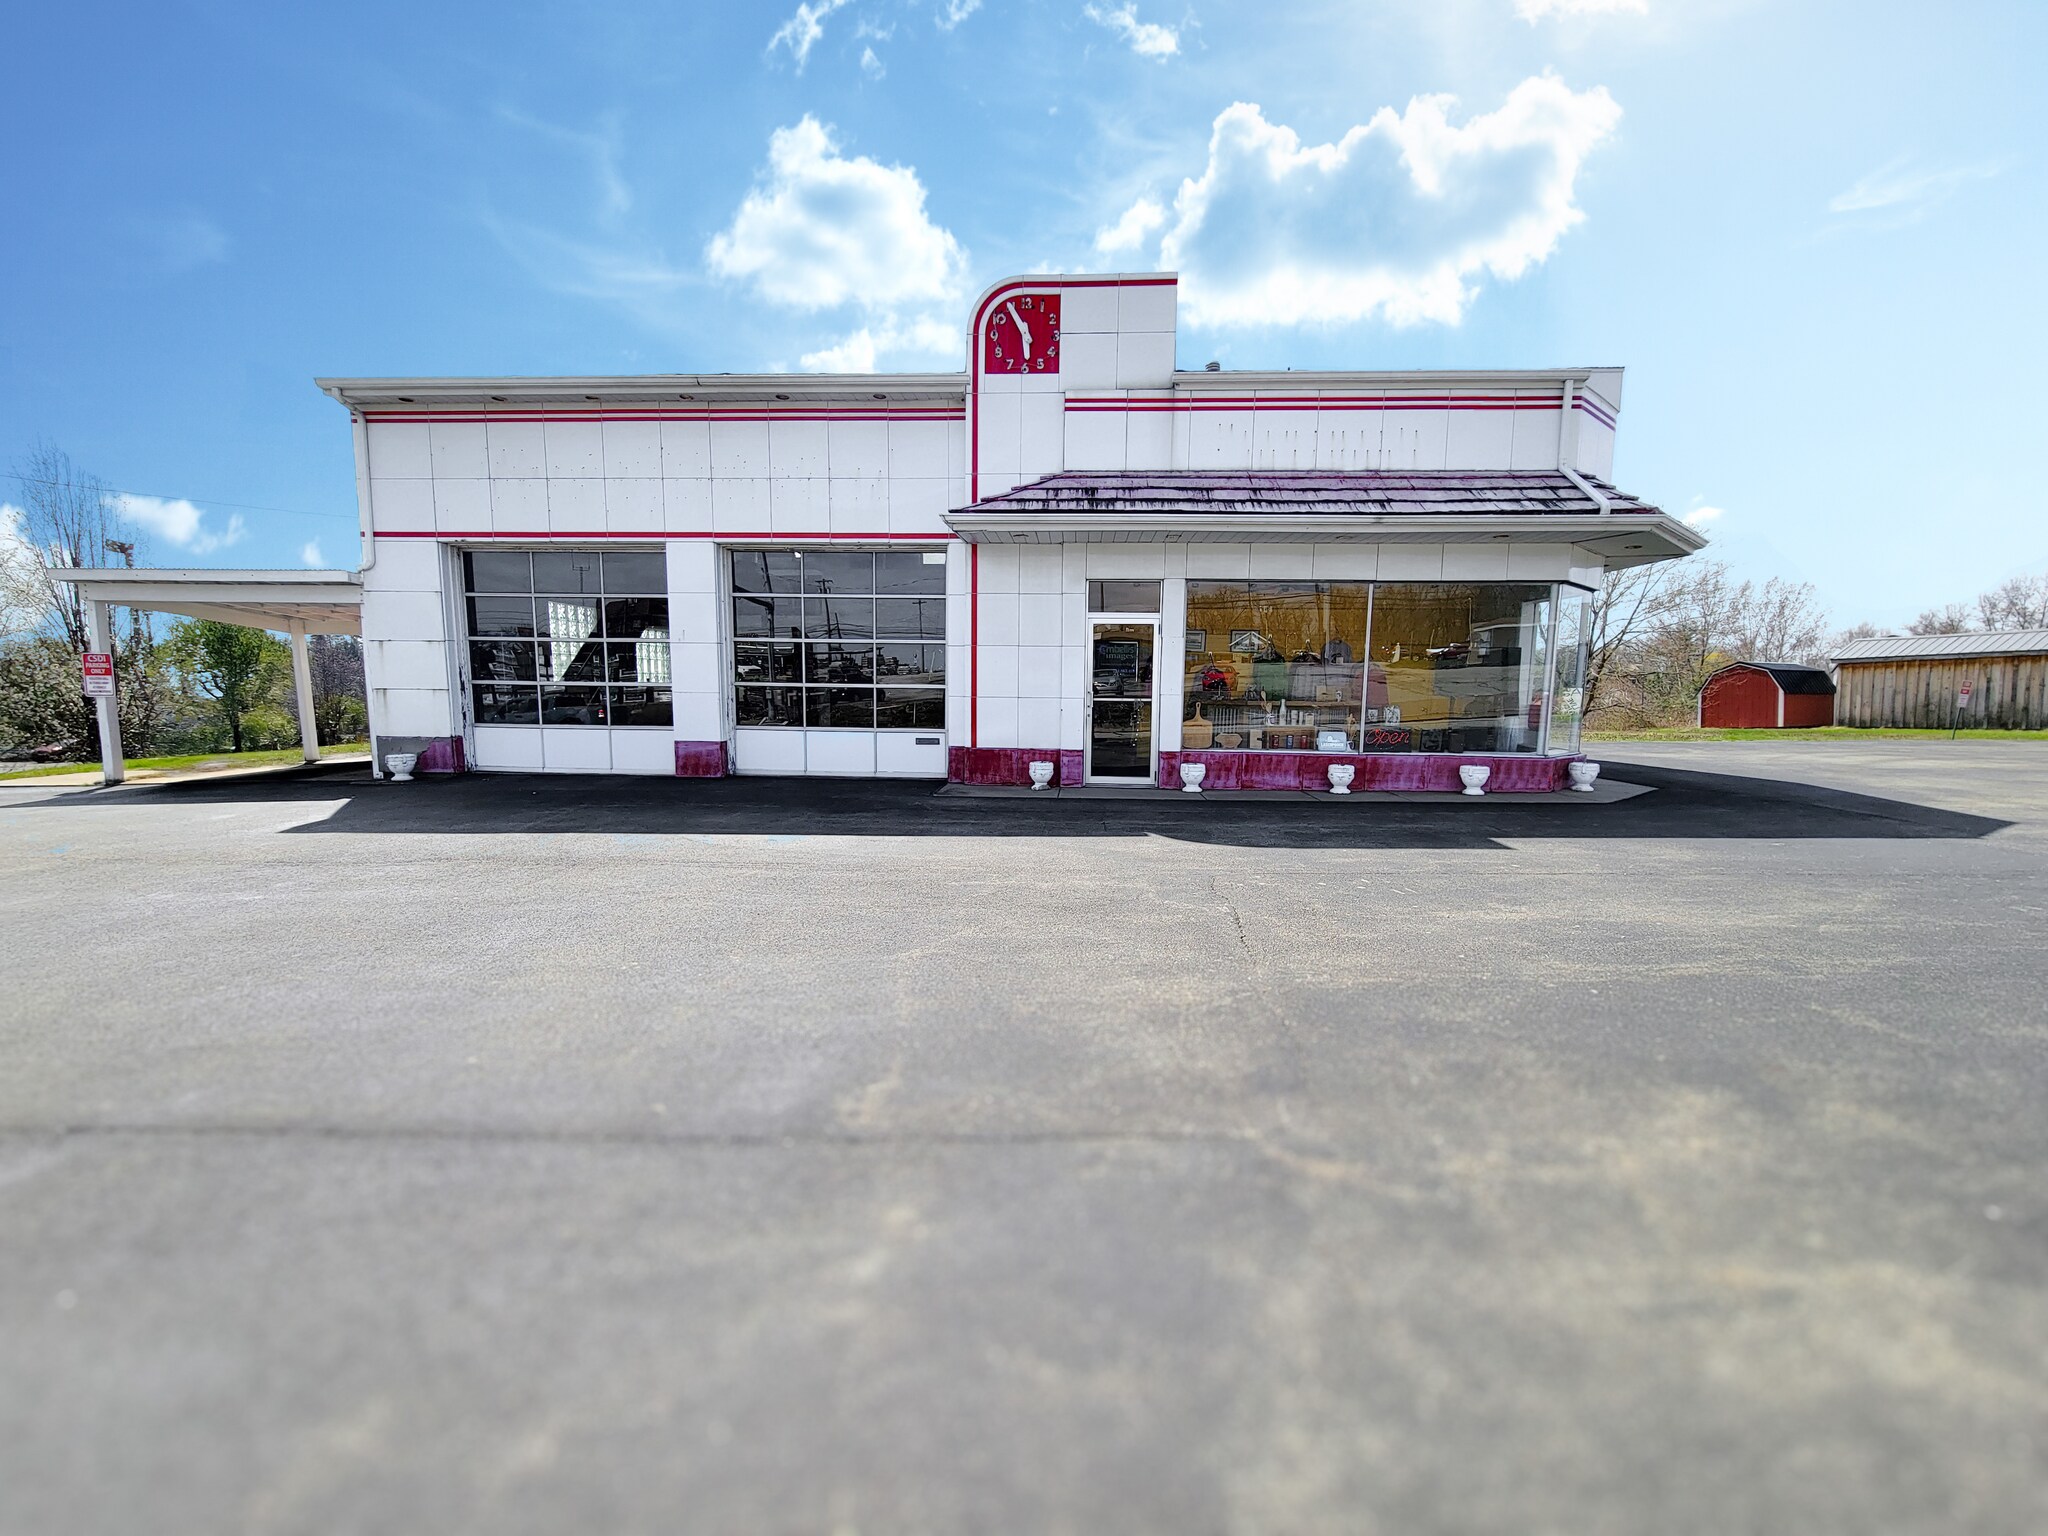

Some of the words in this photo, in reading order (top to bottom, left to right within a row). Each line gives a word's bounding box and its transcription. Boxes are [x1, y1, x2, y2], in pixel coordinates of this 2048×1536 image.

[1049, 313, 1056, 325] 2
[990, 330, 998, 341] 9
[1052, 330, 1059, 341] 3
[995, 347, 1002, 357] 8
[1047, 346, 1056, 357] 4
[1006, 359, 1014, 369] 7
[1021, 363, 1029, 373] 6
[1037, 358, 1044, 369] 5
[1365, 729, 1409, 747] Open
